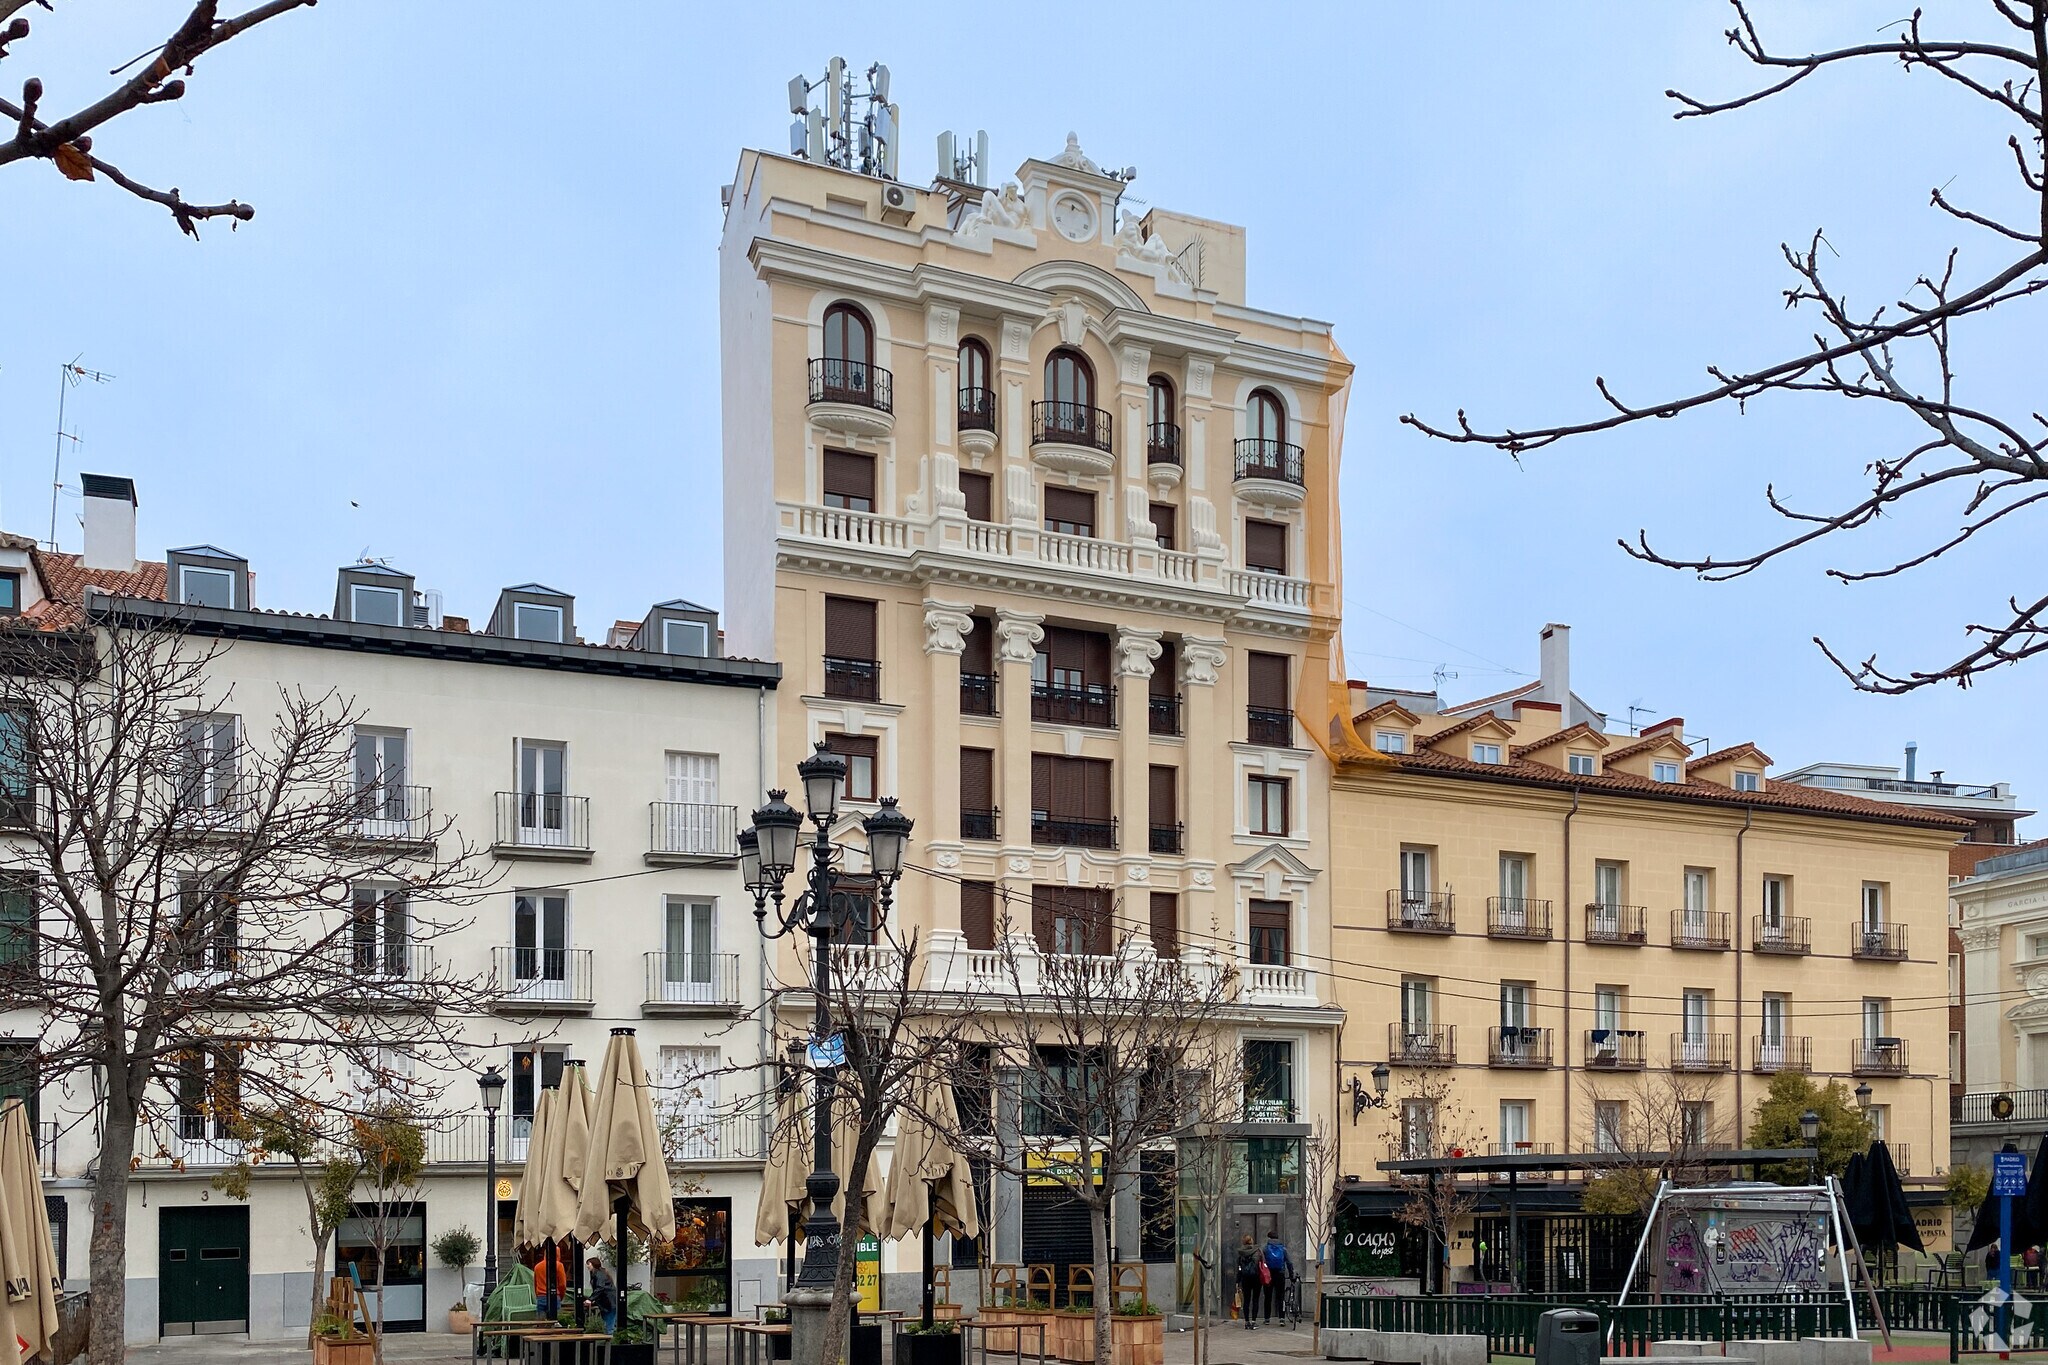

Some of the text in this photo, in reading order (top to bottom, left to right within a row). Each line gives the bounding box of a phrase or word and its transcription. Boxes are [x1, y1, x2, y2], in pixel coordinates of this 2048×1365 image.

[201, 1190, 209, 1202] 3
[1915, 1218, 1943, 1227] ADRID
[1344, 1232, 1354, 1246] O
[856, 1242, 878, 1253] IBLE
